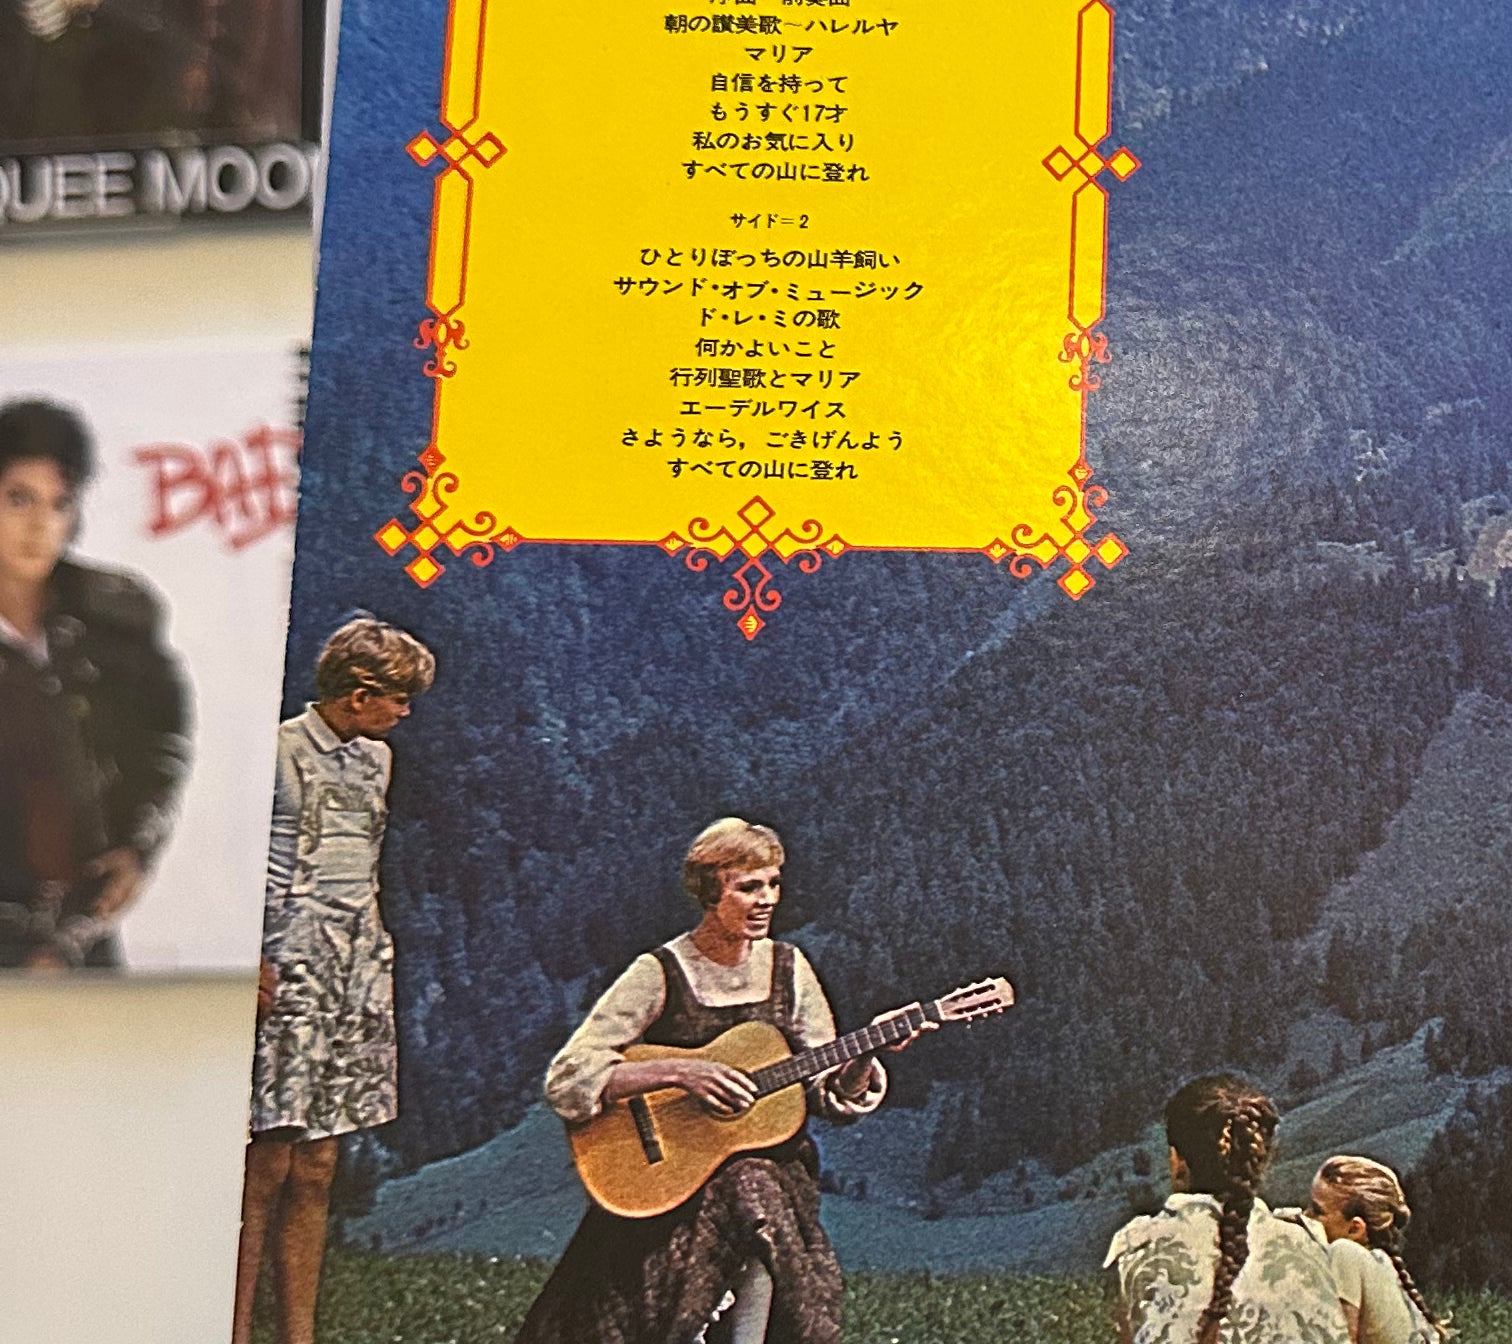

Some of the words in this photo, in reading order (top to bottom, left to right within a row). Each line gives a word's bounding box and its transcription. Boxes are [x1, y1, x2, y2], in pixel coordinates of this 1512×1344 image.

[744, 44, 813, 63] マリア
[710, 72, 849, 94] 自信を持って
[710, 102, 848, 124] もうすぐ17才
[692, 131, 856, 153] 私のお気に入り
[682, 160, 870, 184] すべての山に登れ
[0, 152, 134, 220] UEE
[640, 247, 901, 270] ひとりぼっちの山羊飼い
[613, 276, 925, 302] サウンド・オブ・ミュージック
[700, 307, 841, 330] ド・レ・ミの歌
[695, 337, 836, 359] 何かよいこと
[669, 367, 861, 389] 行列聖歌とマリア
[679, 398, 847, 420] エーデルワイス
[667, 457, 858, 481] すべての山に登れ
